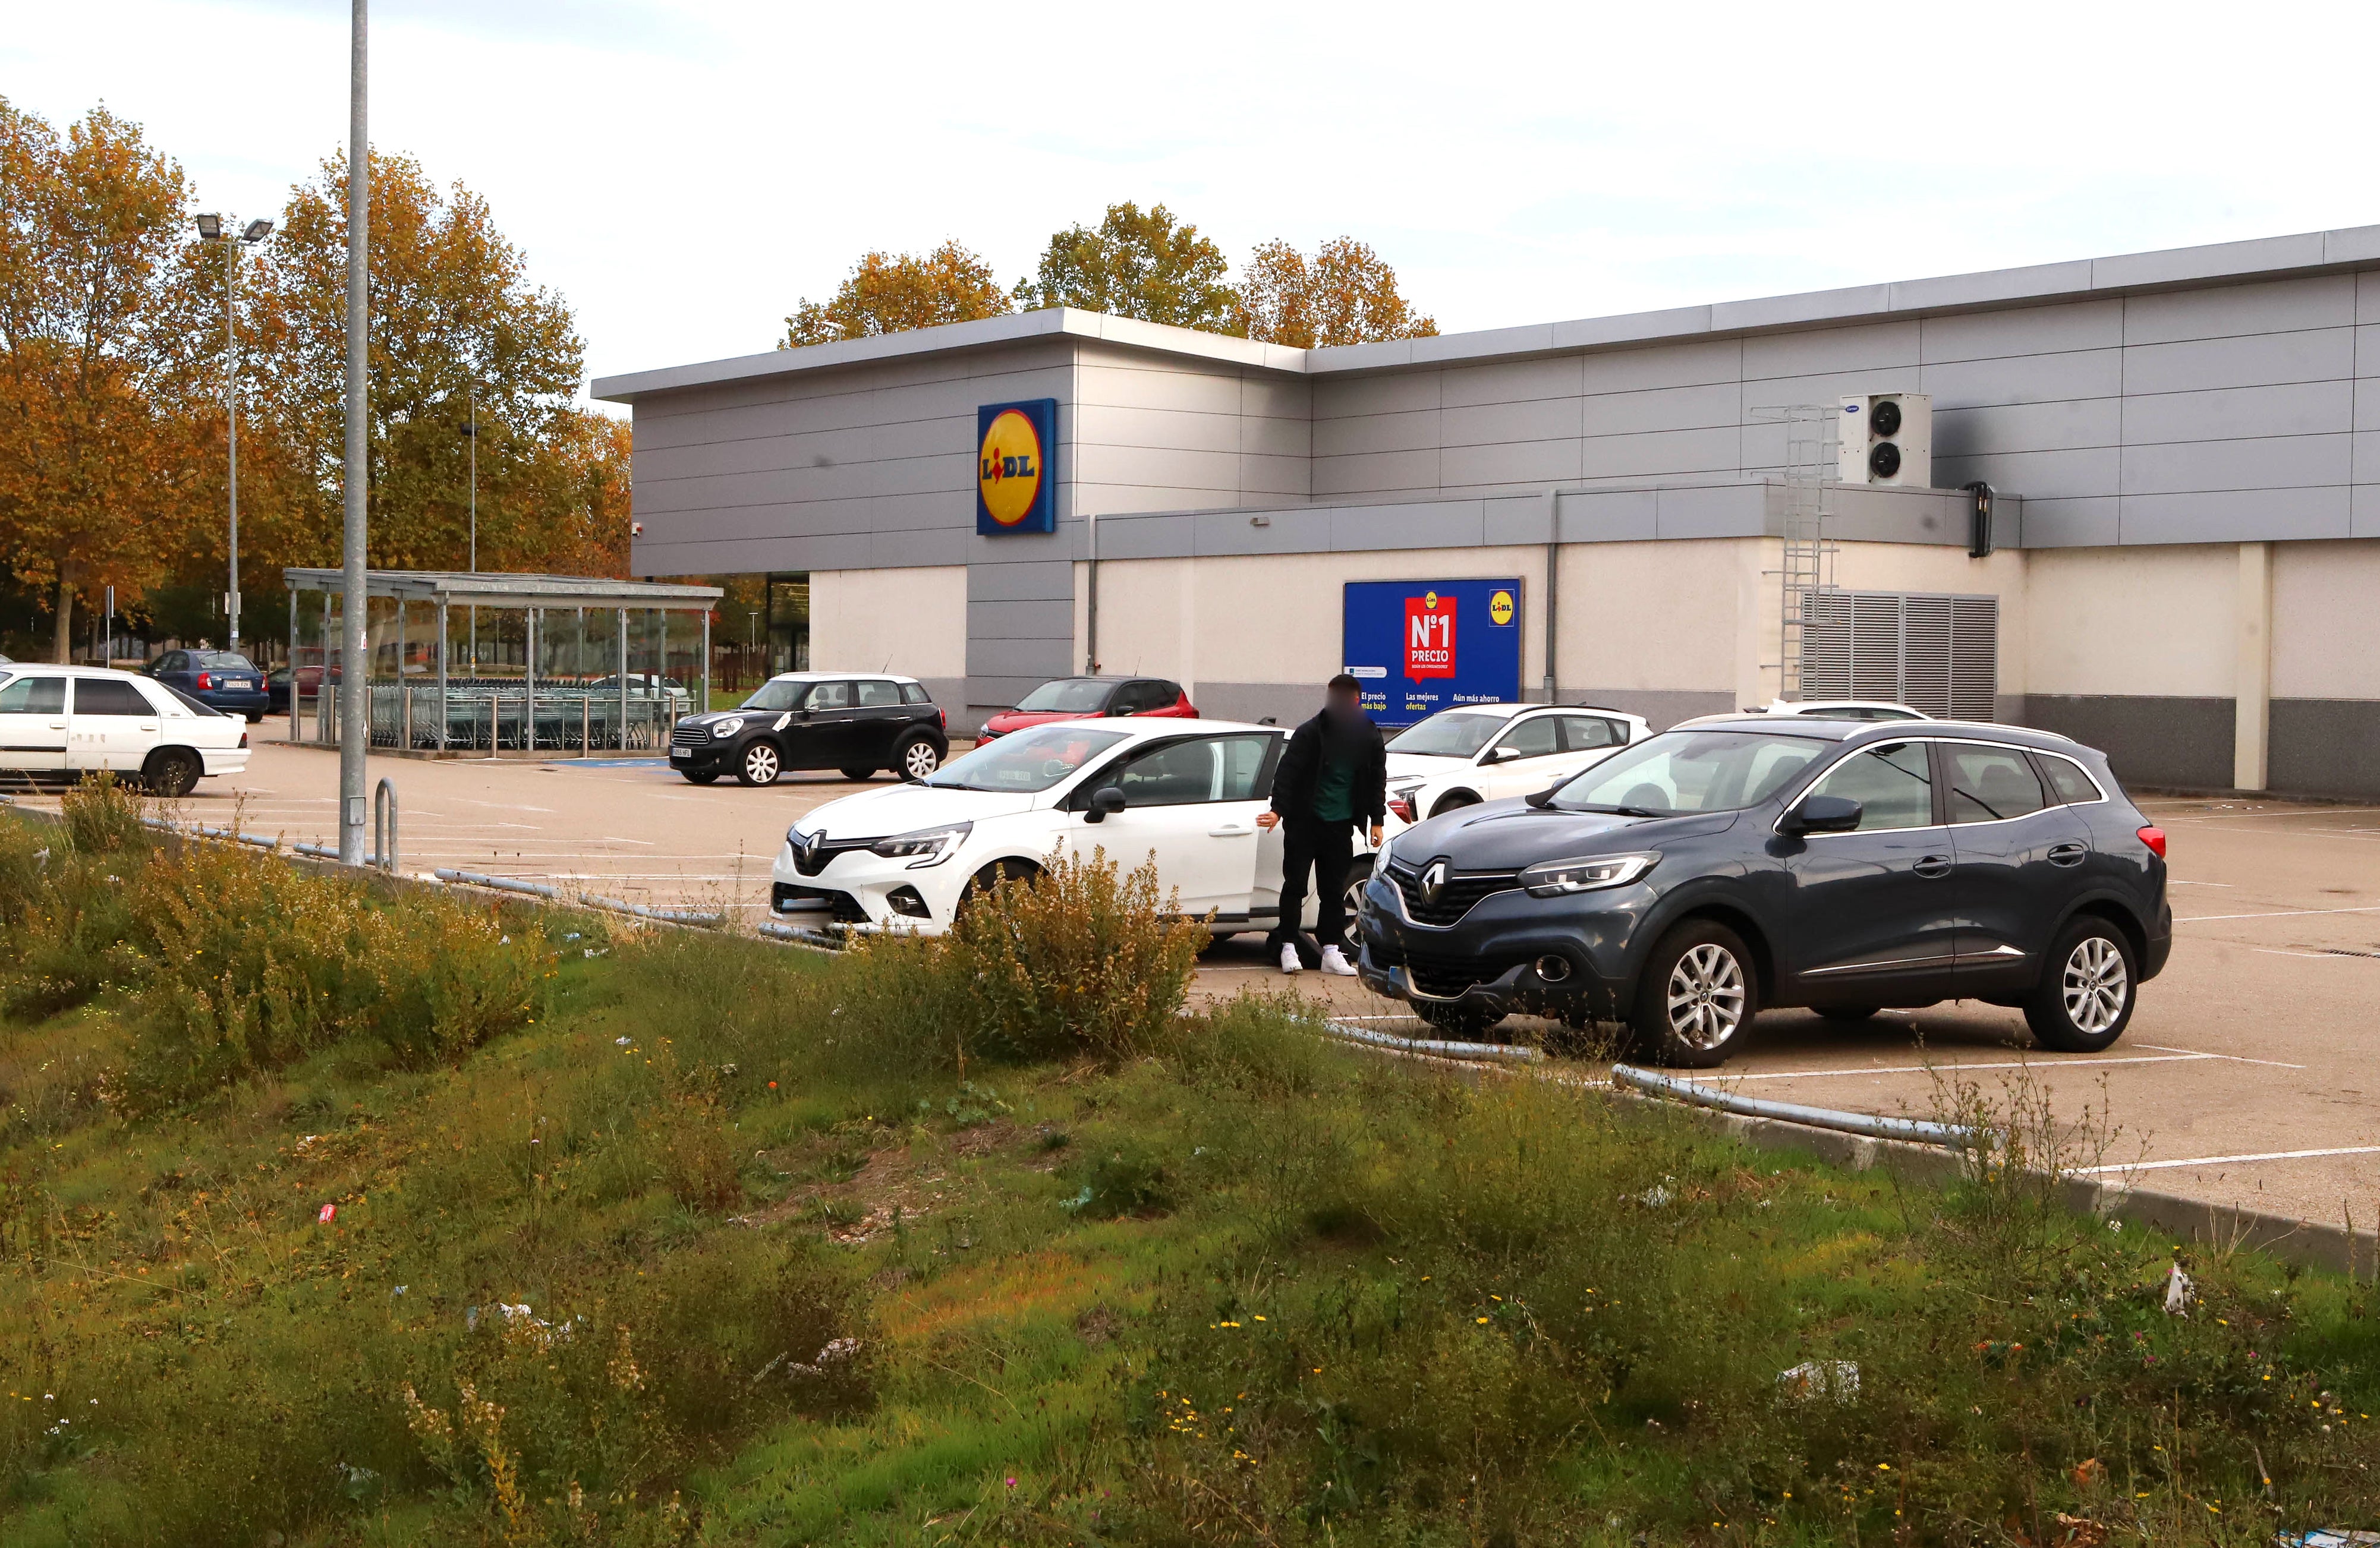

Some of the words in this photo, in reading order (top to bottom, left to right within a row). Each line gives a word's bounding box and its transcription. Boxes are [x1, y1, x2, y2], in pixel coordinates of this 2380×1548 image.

[1411, 650, 1449, 663] PRECIO
[1361, 692, 1367, 700] El
[1368, 692, 1386, 701] precio
[1406, 692, 1416, 701] Las
[1416, 692, 1438, 702] mejores
[1453, 693, 1465, 702] Aún
[1466, 694, 1479, 702] más
[1479, 694, 1500, 703] ahorro
[1361, 701, 1372, 710] más
[1374, 701, 1387, 711] bajo
[1406, 702, 1427, 711] ofertas
